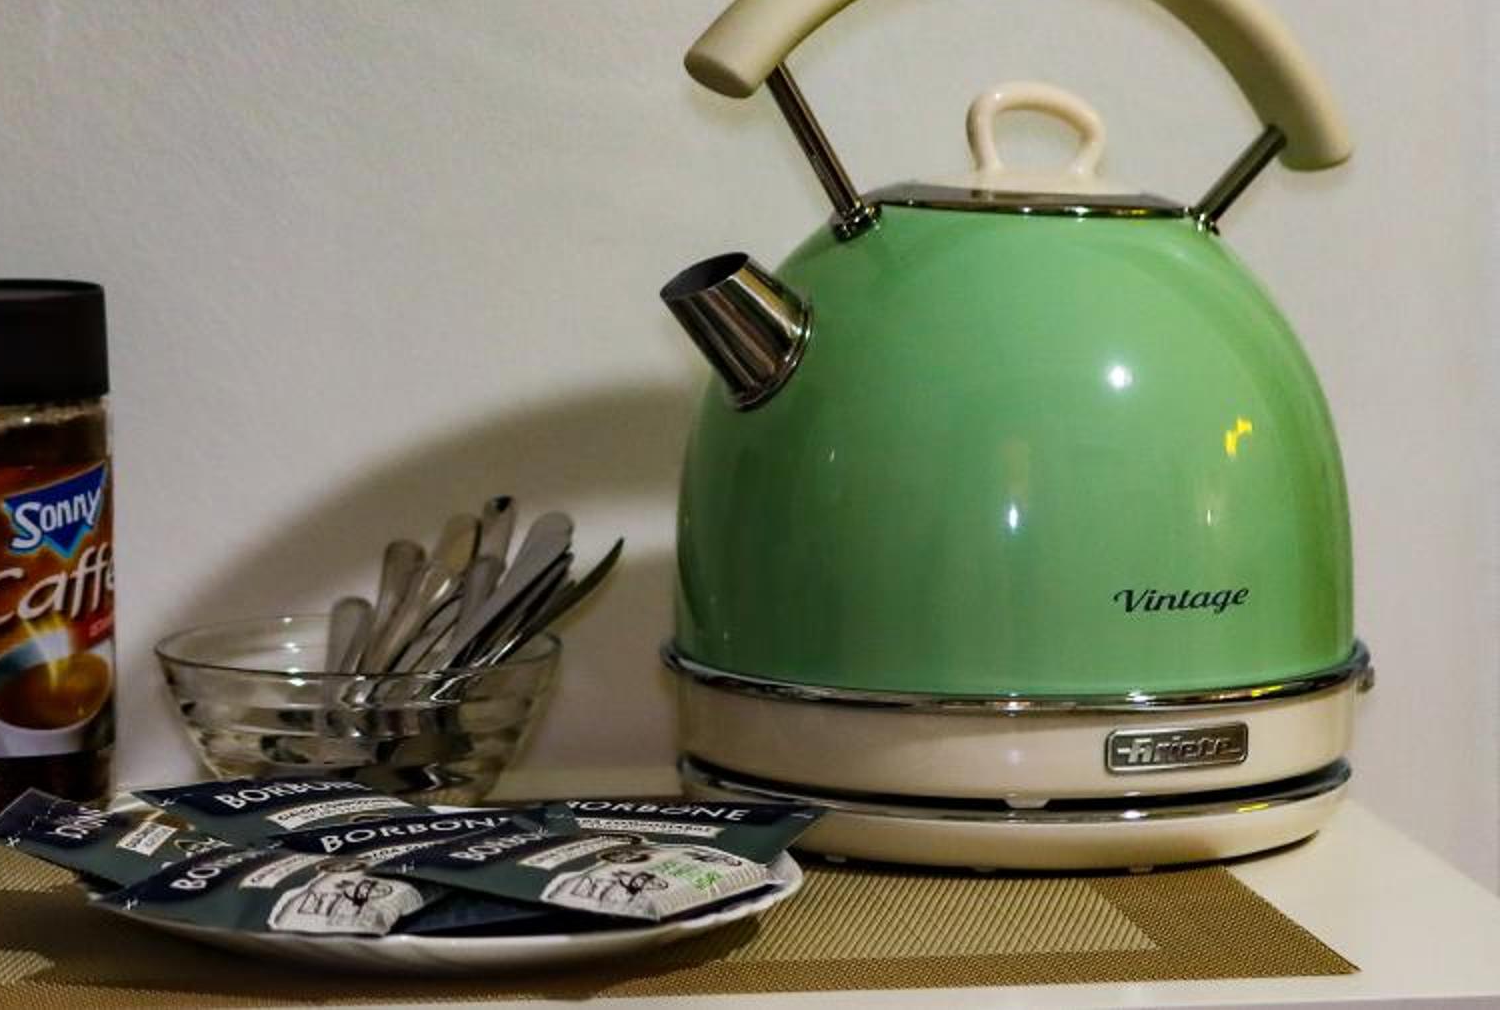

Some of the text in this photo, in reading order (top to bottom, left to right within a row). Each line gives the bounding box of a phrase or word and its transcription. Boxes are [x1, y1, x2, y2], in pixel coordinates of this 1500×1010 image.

[11, 486, 102, 549] Sonny
[1113, 586, 1250, 615] Vintage
[319, 815, 514, 854] BORBON
